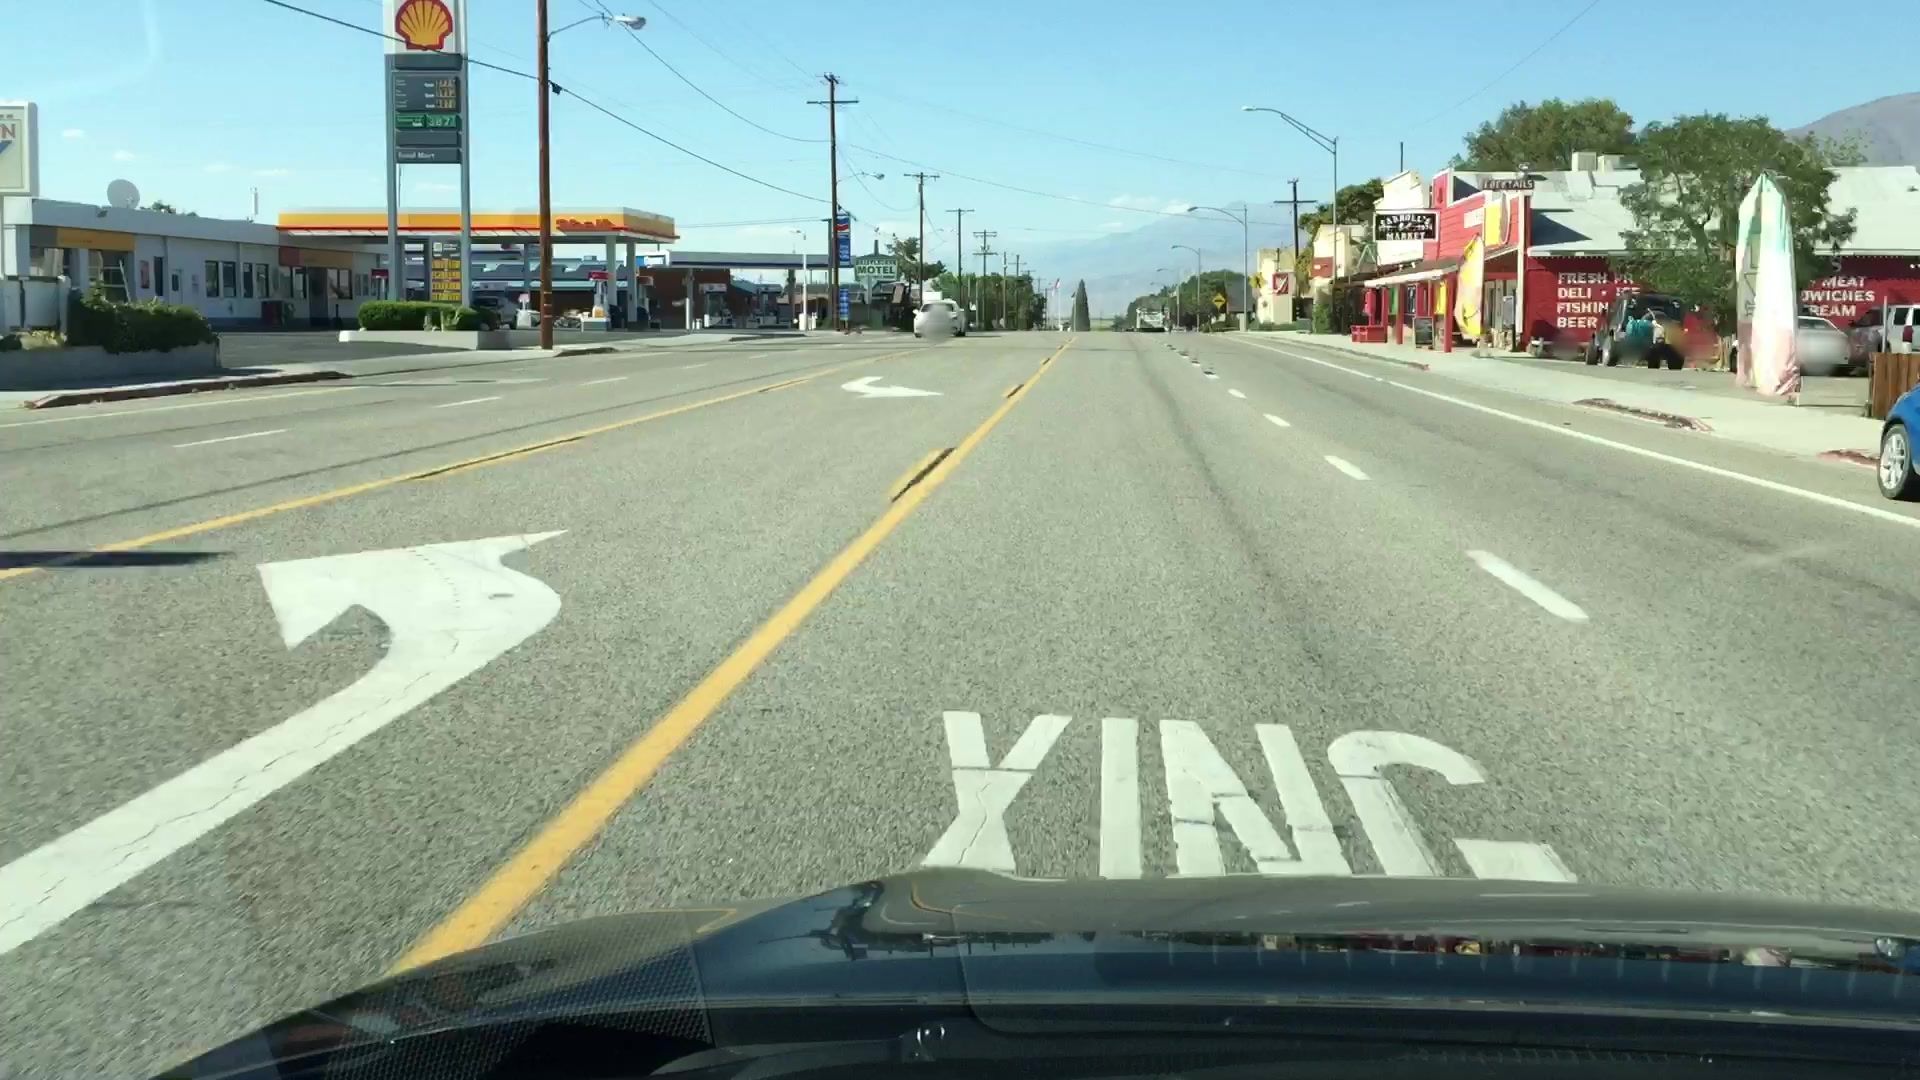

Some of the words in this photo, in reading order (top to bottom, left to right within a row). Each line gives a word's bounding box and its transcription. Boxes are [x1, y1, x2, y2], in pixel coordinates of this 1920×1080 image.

[418, 151, 435, 160] Mart
[857, 265, 895, 274] MOTEL
[1557, 271, 1608, 285] FRESH
[1822, 275, 1867, 288] MEAT
[1557, 287, 1592, 299] DELI
[1557, 316, 1599, 329] BEER
